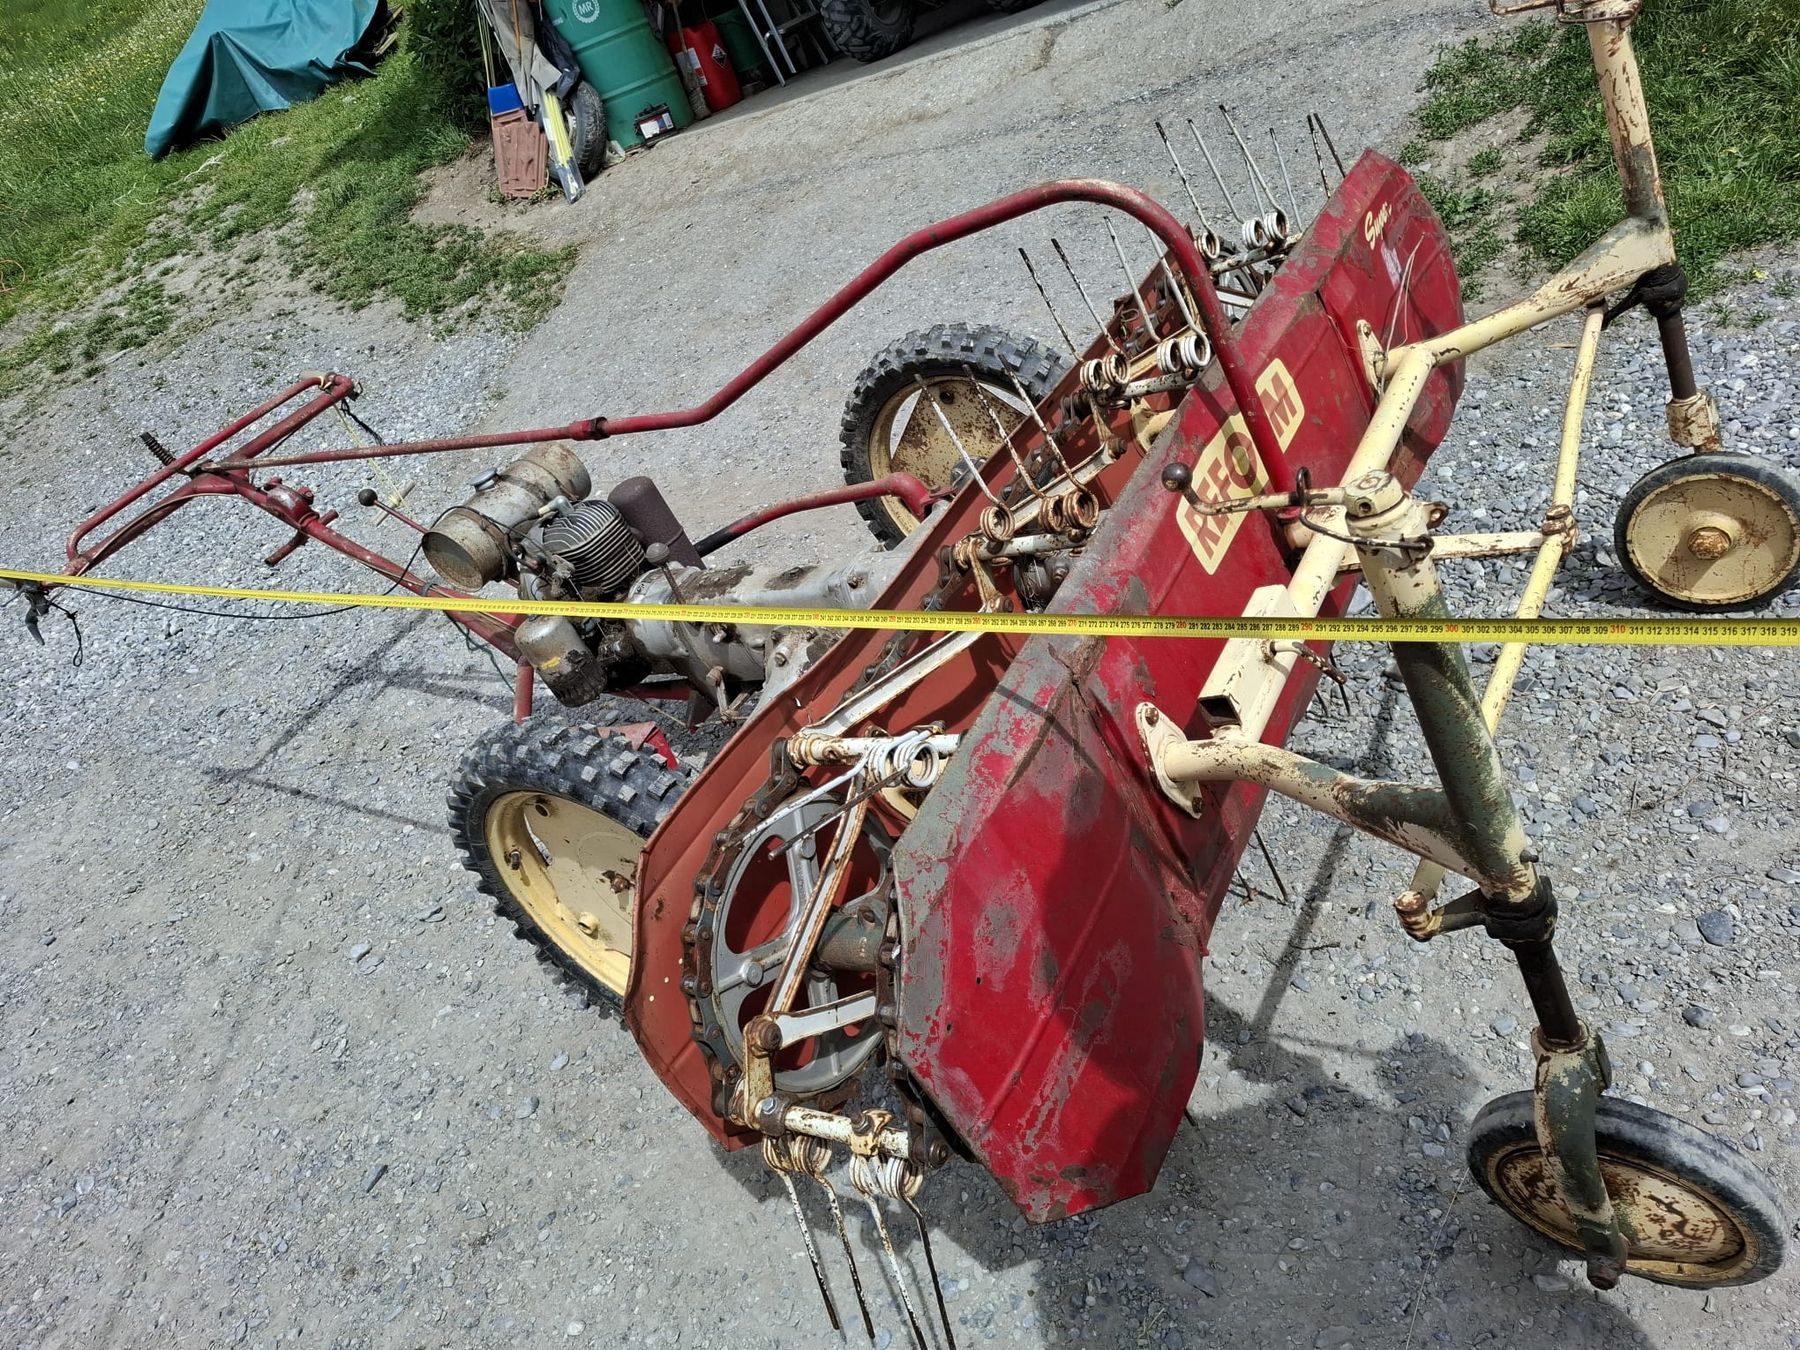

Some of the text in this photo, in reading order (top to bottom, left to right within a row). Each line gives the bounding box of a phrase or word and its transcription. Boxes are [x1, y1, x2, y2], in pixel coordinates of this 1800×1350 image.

[577, 1, 594, 15] MR
[1184, 371, 1298, 560] REFOM
[1088, 620, 1098, 628] 272
[1099, 620, 1108, 628] 273
[1109, 620, 1119, 628] 274
[1131, 621, 1141, 629] 276
[1142, 621, 1152, 629] 277
[1153, 621, 1163, 629] 278
[1165, 621, 1175, 629] 279
[1189, 622, 1199, 630] 281
[1200, 622, 1210, 630] 282
[1212, 622, 1223, 630] 283
[1224, 622, 1235, 630] 284
[1249, 623, 1260, 631] 286
[1262, 623, 1273, 631] 287
[1275, 623, 1286, 631] 288
[1301, 623, 1313, 631] 290
[1315, 624, 1327, 632] 291
[1329, 624, 1341, 632] 292
[1343, 624, 1355, 632] 293
[1357, 625, 1369, 633] 294
[1371, 625, 1383, 633] 295
[1386, 625, 1398, 633] 296
[1400, 625, 1412, 633] 297
[1415, 625, 1428, 633] 298
[1430, 625, 1443, 633] 299
[1445, 624, 1459, 633] 300
[1462, 625, 1474, 634] 301
[1477, 626, 1490, 634] 302
[1493, 626, 1506, 634] 303
[1509, 626, 1523, 634] 304
[1525, 626, 1539, 634] 305
[1542, 626, 1556, 634] 306
[1559, 626, 1573, 634] 307
[1576, 626, 1591, 634] 308
[1593, 626, 1608, 635] 309
[1610, 625, 1626, 634] 310
[1630, 626, 1644, 635] 311
[1647, 626, 1662, 635] 312
[1665, 626, 1681, 635] 313
[1684, 626, 1699, 635] 314
[1702, 626, 1718, 635] 315
[1722, 627, 1738, 636] 316
[1741, 627, 1757, 636] 317
[1761, 627, 1777, 636] 318
[1781, 627, 1798, 636] 319
